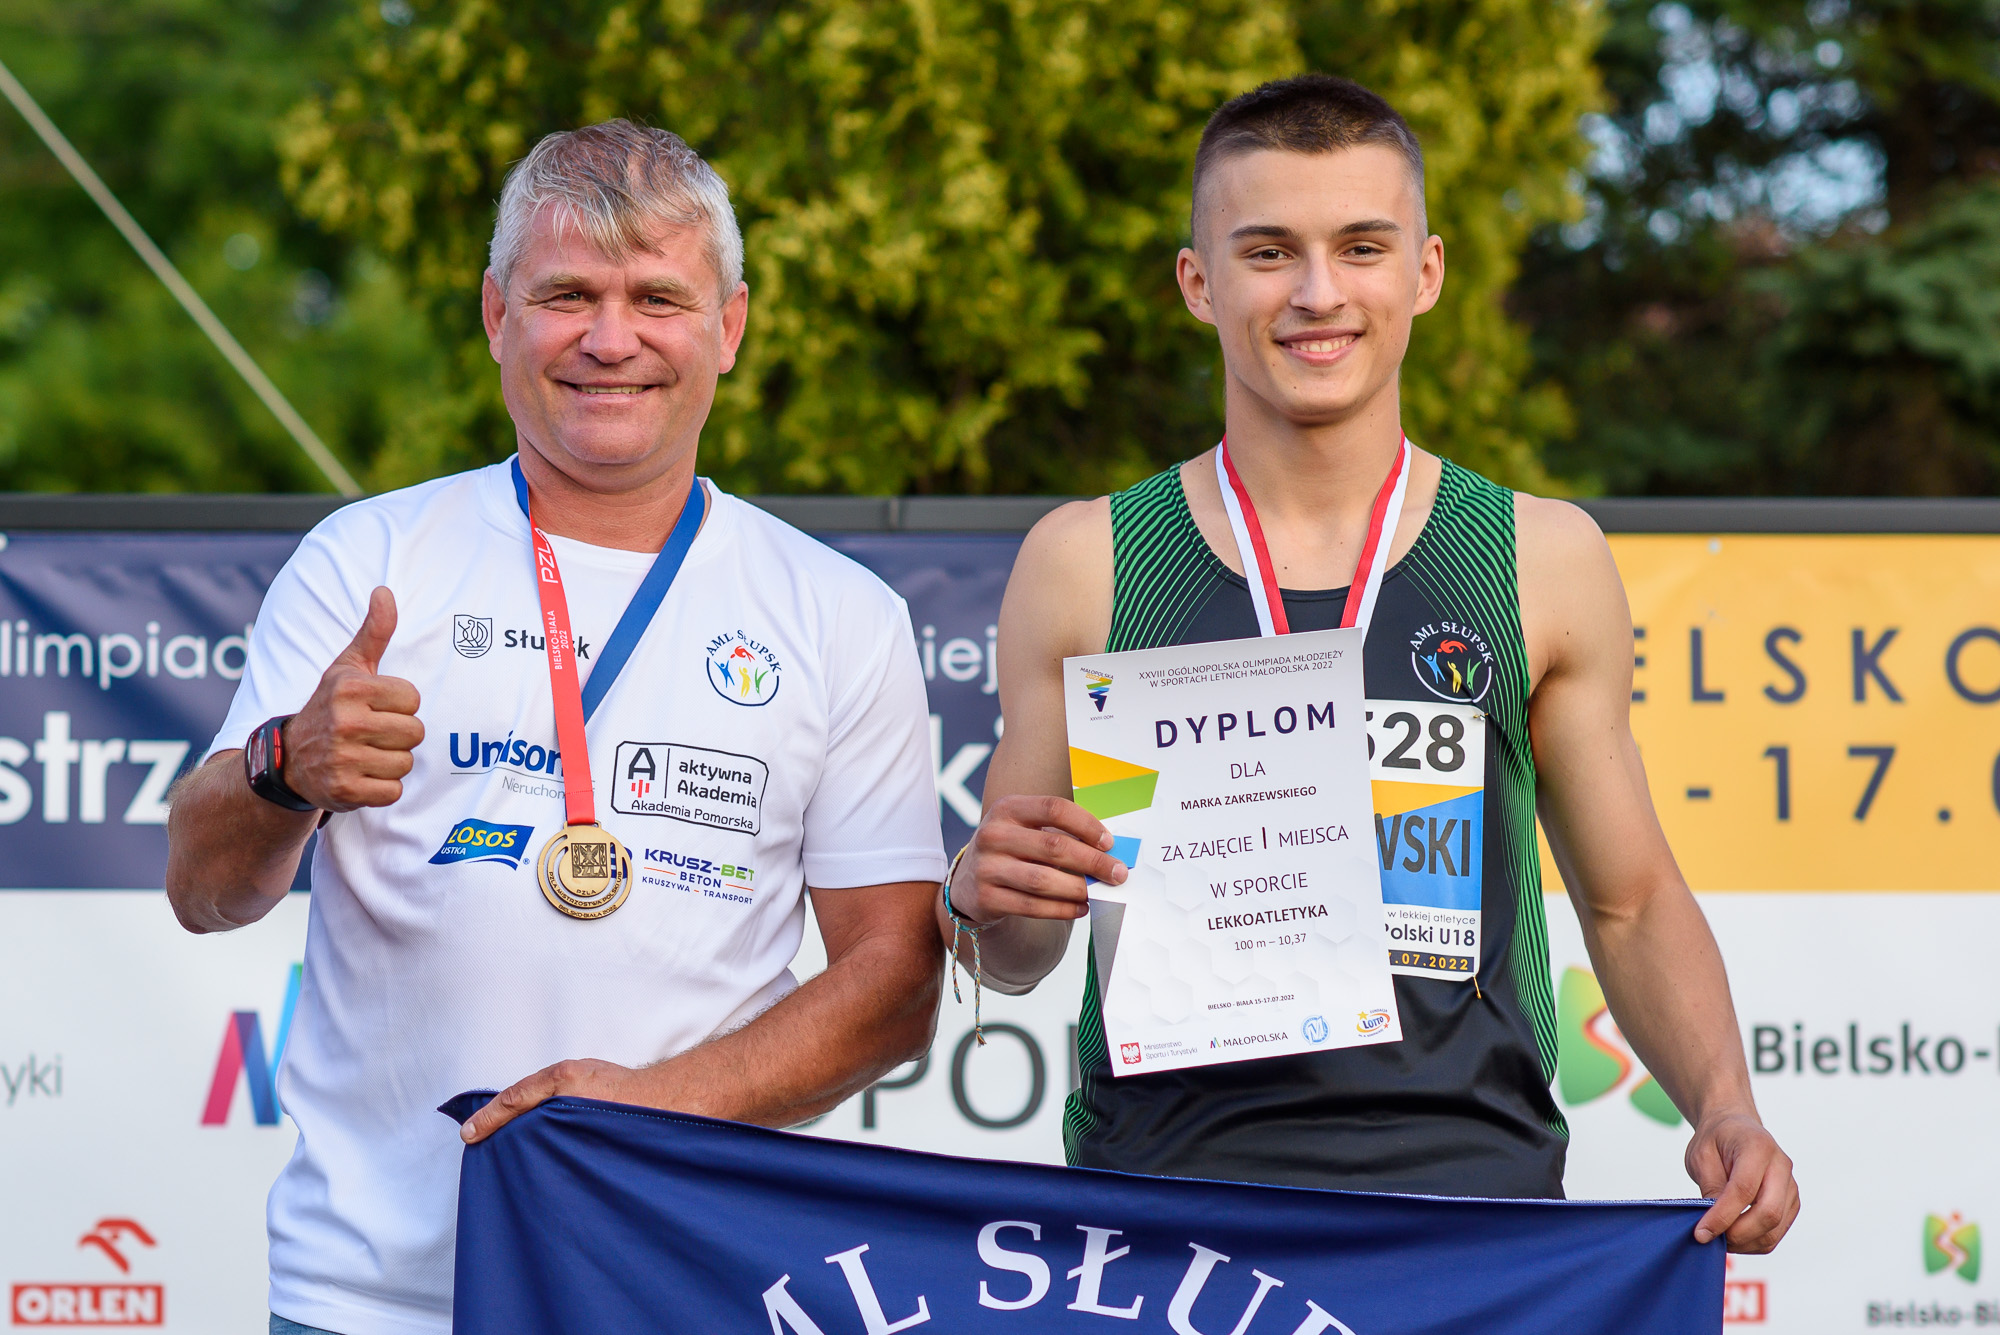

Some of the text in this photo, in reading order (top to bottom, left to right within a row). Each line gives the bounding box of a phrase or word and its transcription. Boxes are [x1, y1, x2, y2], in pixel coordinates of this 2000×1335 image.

[547, 610, 562, 670] BIELSKO-BIAŁA
[559, 630, 569, 649] 2022
[706, 633, 734, 656] AML
[1410, 621, 1494, 664] AML SŁUPSK
[1139, 650, 1344, 680] XXVIII OGÓLNOPOLSKA OLIMPIADA MŁODZIEŻY
[1149, 660, 1334, 688] W SPORTACH LETNICH MAŁOPOLSKA 2022
[1155, 701, 1336, 748] DYPLOM
[1366, 711, 1465, 772] 28
[679, 759, 752, 785] aktywna
[1230, 760, 1266, 779] DLA
[677, 779, 757, 809] Akademia
[1181, 785, 1317, 810] MARKA ZAKRZEWSKIEGO
[631, 799, 753, 829] Akademia Pomorska
[447, 826, 518, 848] ŁOSOŚ
[1161, 845, 1185, 862] ZA
[1188, 836, 1254, 859] ZAJĘCIE
[1278, 825, 1349, 848] MIEJSCA
[440, 846, 467, 856] USTKA
[644, 848, 755, 881] KRUSZ-BET
[576, 888, 597, 896] PZLA
[642, 876, 691, 893] KRUSZYWA
[703, 889, 753, 905] TRANSPORT
[679, 871, 722, 888] BETON
[1210, 872, 1309, 899] W SPORCIE
[1207, 904, 1329, 931] LEKKOATLETYKA
[1399, 910, 1431, 923] lekkiej
[1433, 914, 1476, 926] atletyce
[1234, 939, 1254, 951] 100
[1256, 940, 1266, 948] m
[1278, 933, 1307, 946] 10,37
[1440, 927, 1475, 947] U18
[1207, 1001, 1232, 1010] BIELSKO
[1236, 999, 1254, 1007] BIAŁA
[1254, 994, 1295, 1005] 15-17.07.2022
[1362, 1016, 1384, 1029] LOTTO
[1144, 1041, 1183, 1051] Ministerstwo
[1223, 1031, 1289, 1048] MAŁOPOLSKA
[1753, 1021, 2000, 1075] Bielsko-
[1145, 1050, 1167, 1060] Sportu
[1170, 1046, 1198, 1058] Turystyki
[0, 1053, 62, 1107] yki
[16, 1286, 158, 1322] ORLEN
